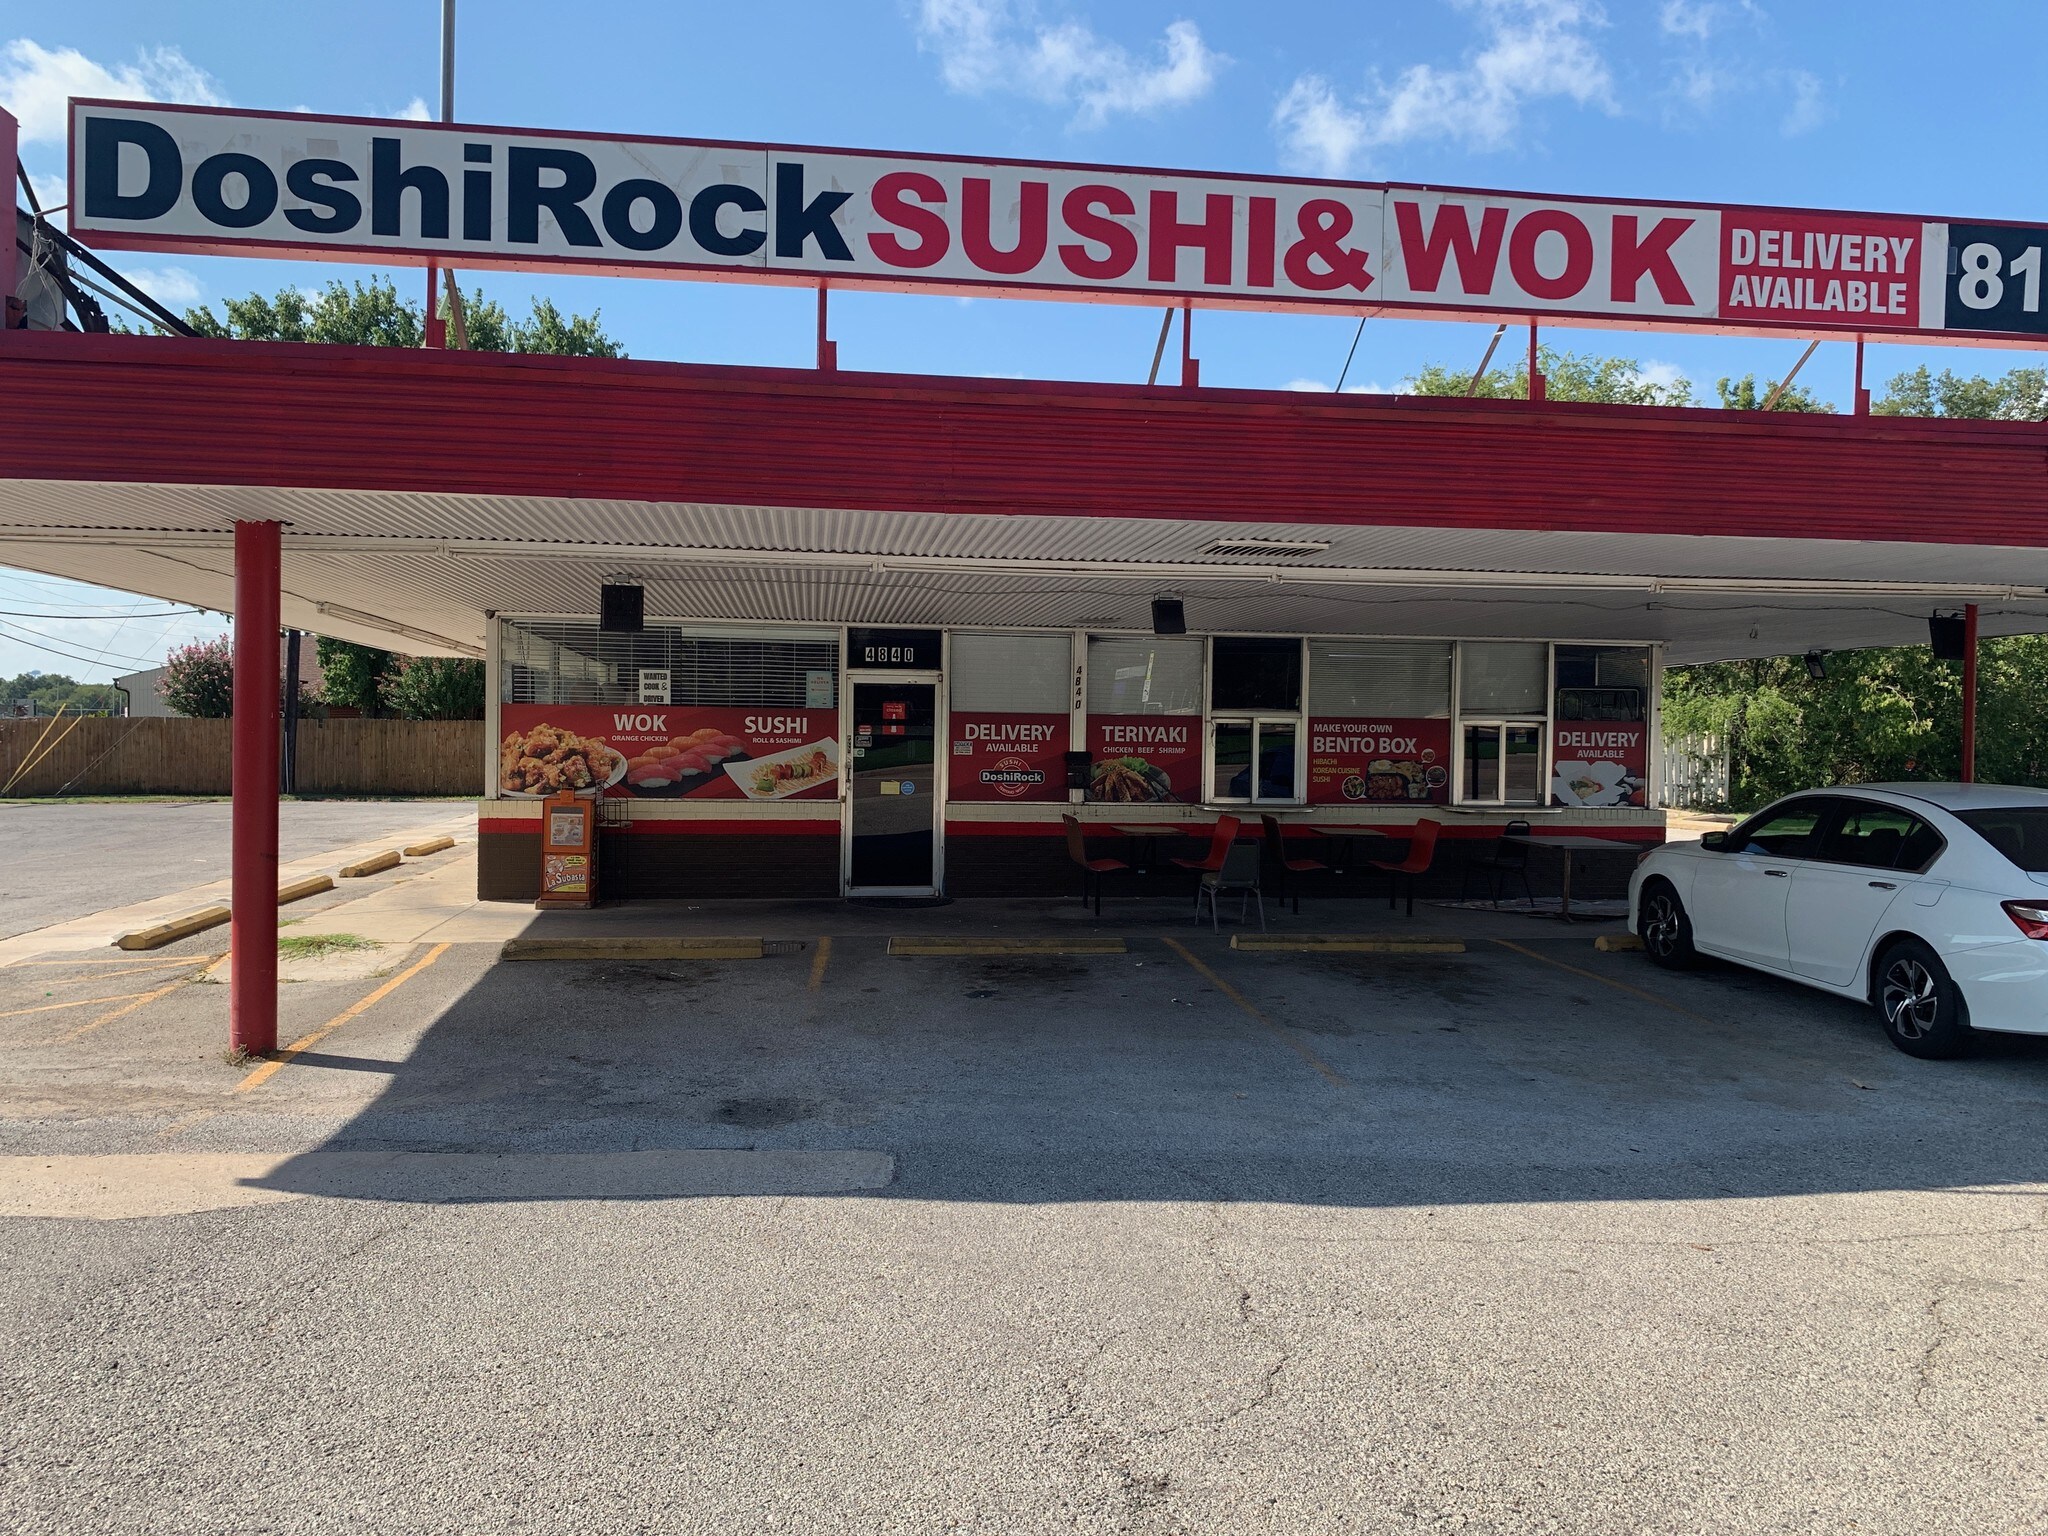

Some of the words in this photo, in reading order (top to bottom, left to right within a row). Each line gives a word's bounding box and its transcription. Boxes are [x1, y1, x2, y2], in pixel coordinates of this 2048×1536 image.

[1731, 228, 1914, 274] DELIVERY
[1958, 242, 2042, 312] 81
[1729, 275, 1907, 315] AVAILABLE
[866, 647, 913, 662] 4840
[643, 672, 668, 681] WANTED
[643, 682, 660, 690] COOK
[660, 682, 668, 690] &
[613, 714, 667, 732] WOK
[744, 716, 808, 734] SUSHI
[1313, 723, 1341, 732] MAKE
[1342, 724, 1368, 732] YOUR
[1369, 724, 1393, 733] OWN
[965, 724, 1055, 741] DELIVERY
[1101, 726, 1187, 742] TERIYAKI
[1558, 731, 1640, 748] DELIVERY
[985, 743, 1039, 753] AVAILABLE
[1313, 736, 1375, 753] BENTO
[1378, 737, 1418, 754] BOX
[1576, 749, 1625, 758] AVAILABLE
[999, 759, 1022, 768] SUSHI
[982, 772, 1042, 782] DoshiRock
[555, 872, 585, 884] Subasta
